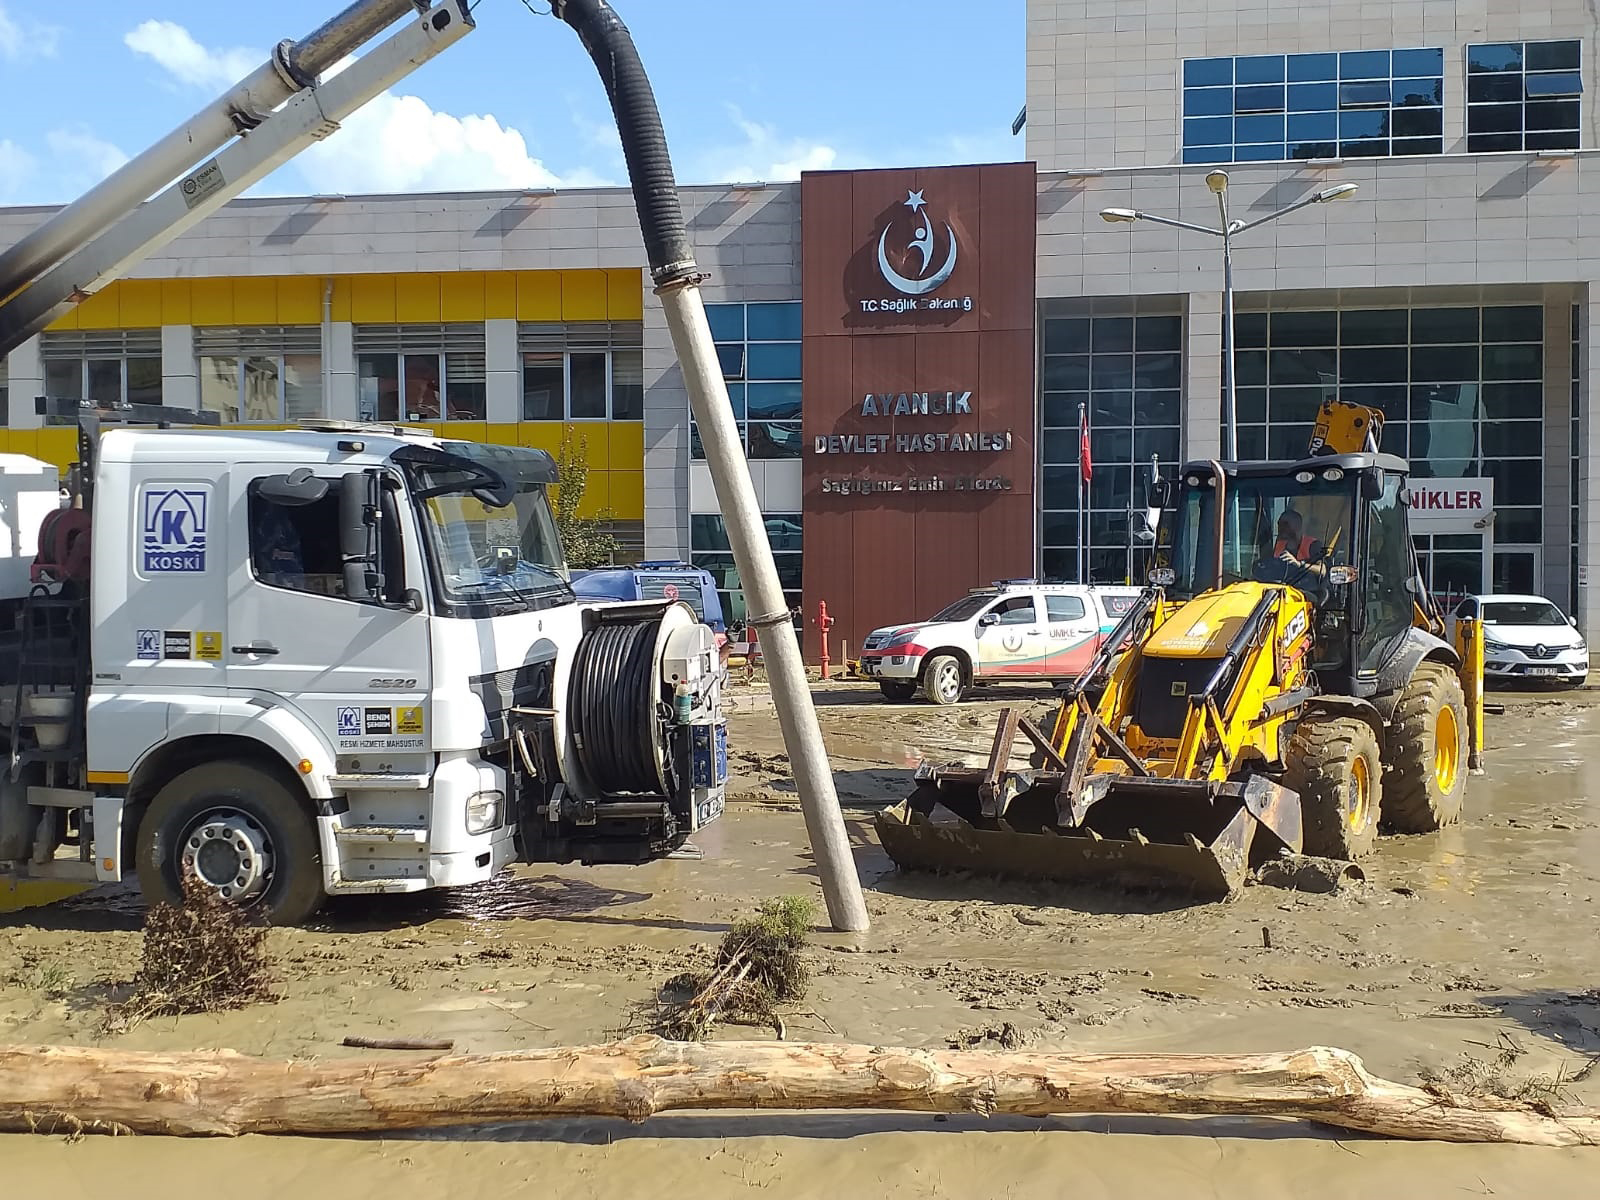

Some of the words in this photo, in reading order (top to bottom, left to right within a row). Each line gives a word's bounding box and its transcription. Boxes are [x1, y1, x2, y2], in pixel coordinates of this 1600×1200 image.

[880, 298, 917, 314] Sağlık
[861, 391, 973, 417] AYANCIK
[814, 434, 890, 454] DEVLET
[896, 427, 1013, 453] HASTANESİ
[161, 511, 187, 544] K
[149, 554, 200, 570] KOSKİ
[1284, 609, 1306, 649] JCB
[344, 714, 354, 726] K
